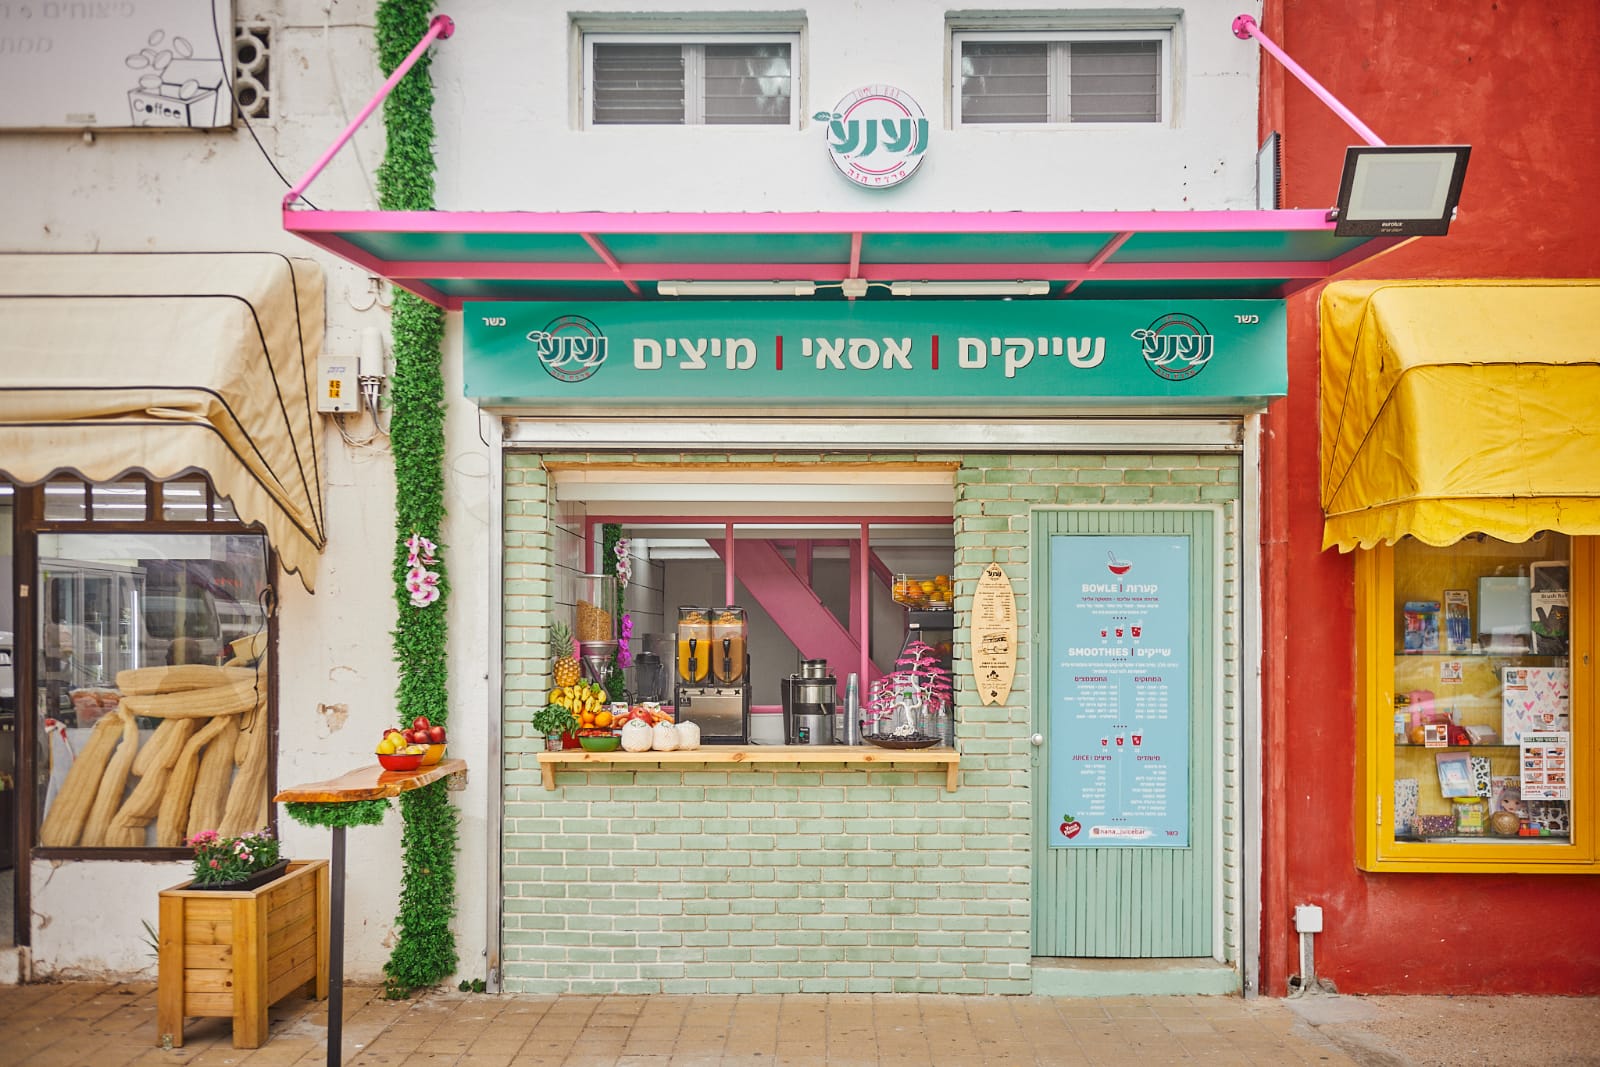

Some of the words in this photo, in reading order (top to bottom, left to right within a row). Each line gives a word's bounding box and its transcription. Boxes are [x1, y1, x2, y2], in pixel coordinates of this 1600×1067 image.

[132, 99, 182, 120] Coffee
[829, 117, 929, 157] נענע
[482, 316, 506, 327] כשר
[1234, 314, 1260, 324] כשר
[538, 335, 609, 367] נענע
[633, 338, 757, 370] מיצים
[800, 337, 914, 370] אסאי
[957, 336, 1107, 378] שייקים
[1142, 334, 1214, 366] נענע
[1082, 584, 1118, 593] BOWLE
[1126, 584, 1158, 594] קערות
[1068, 647, 1129, 657] SMOOTHIES
[1137, 648, 1171, 658] שייקים
